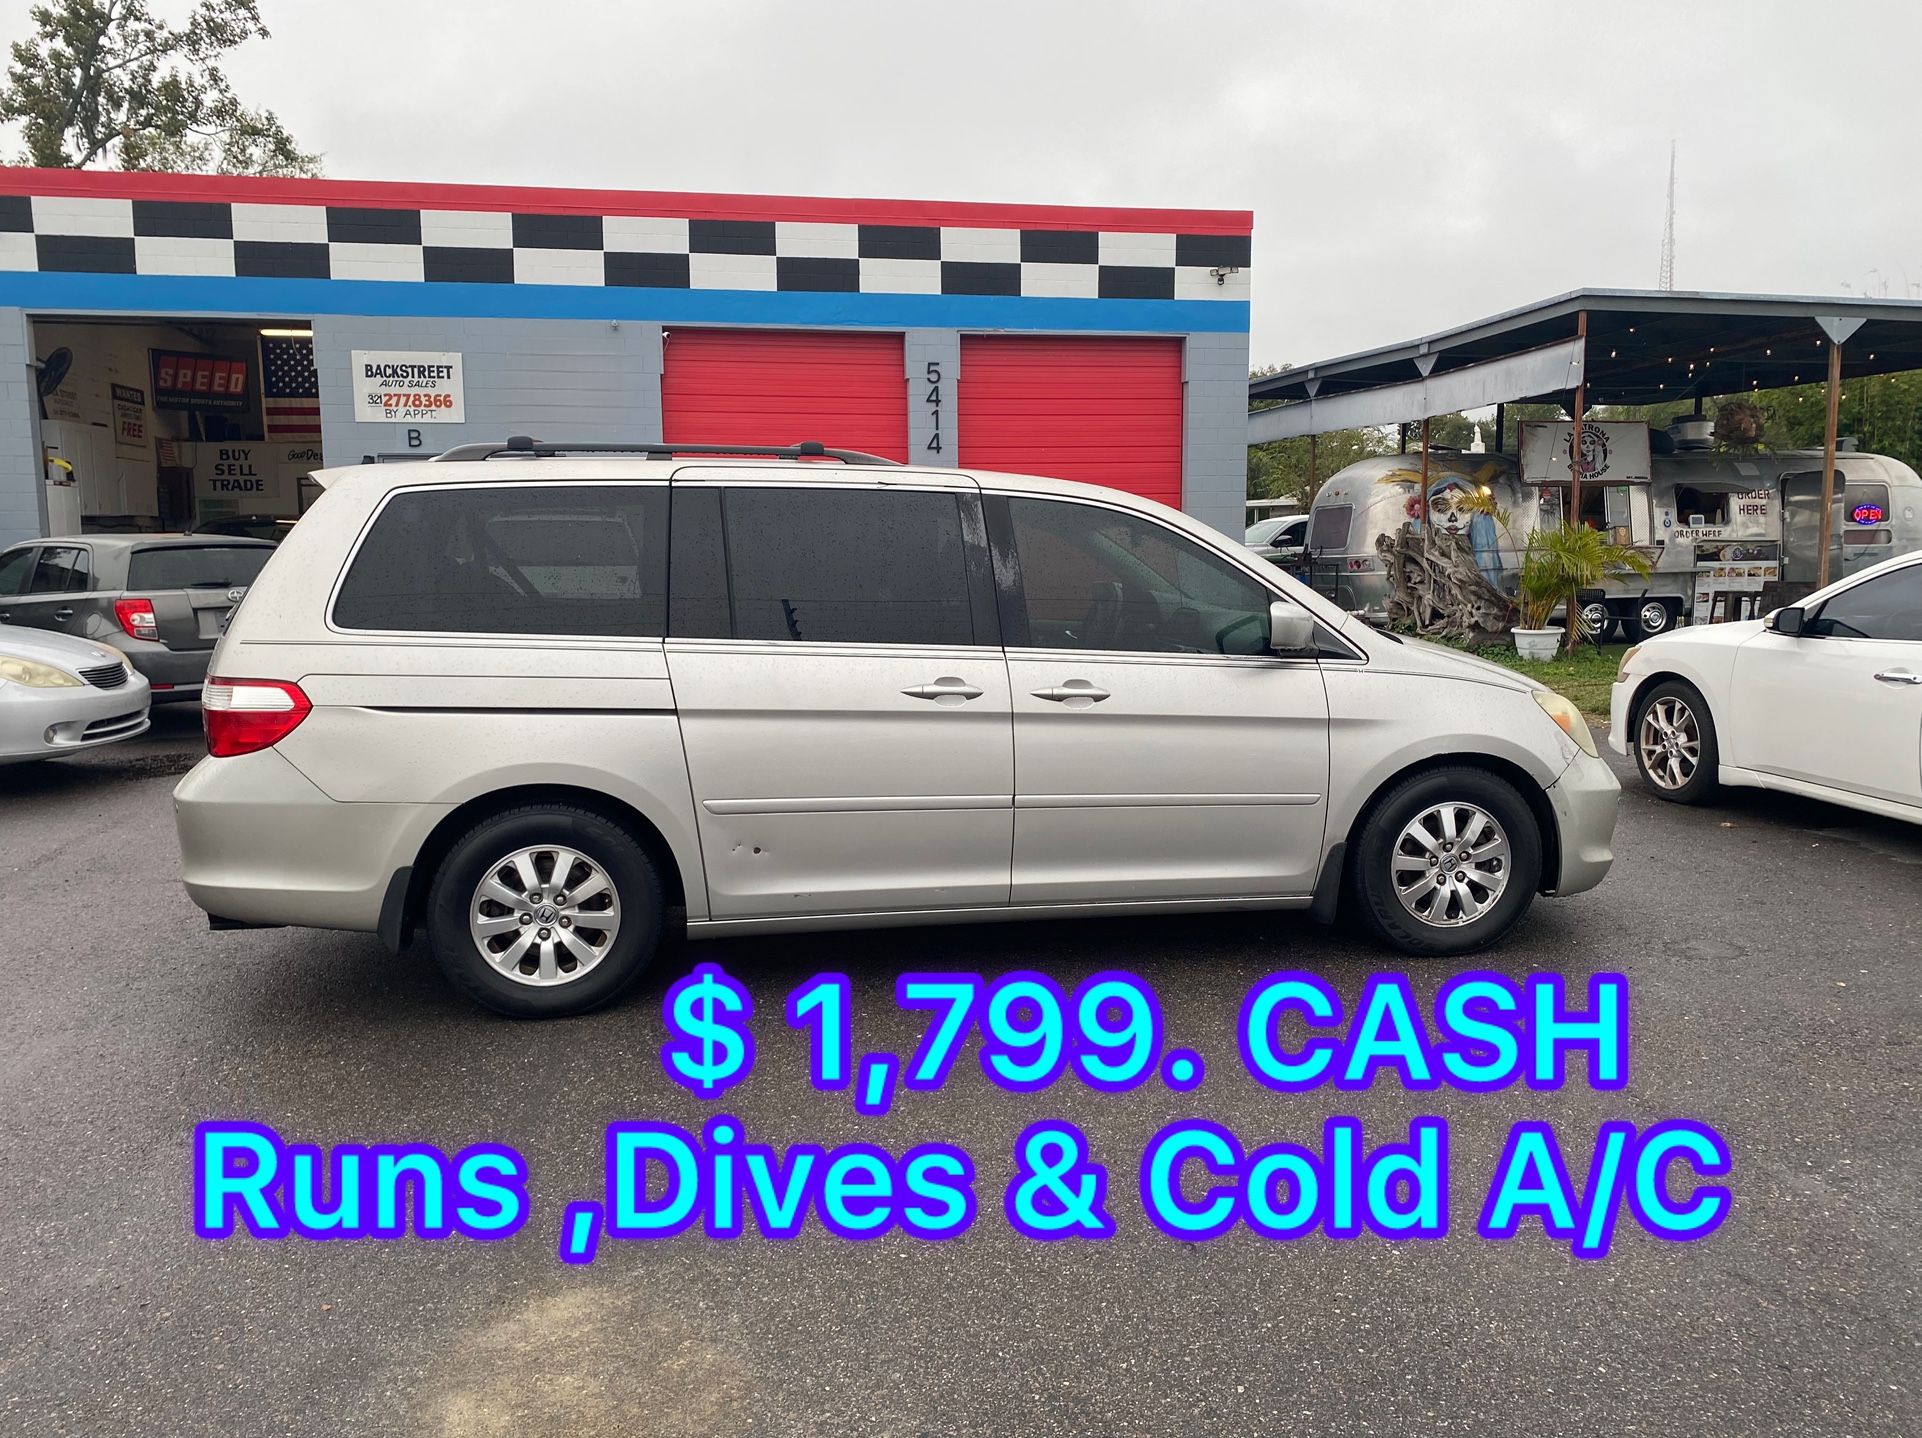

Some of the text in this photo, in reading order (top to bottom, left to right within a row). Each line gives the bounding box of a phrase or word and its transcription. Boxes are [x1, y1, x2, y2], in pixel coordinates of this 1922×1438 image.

[364, 364, 453, 379] BACKSTREET
[159, 368, 244, 392] SPEED
[379, 379, 437, 388] AUTO SALES
[367, 393, 382, 405] 321
[385, 409, 437, 419] BY APPT.
[925, 362, 942, 454] 5414
[121, 421, 143, 439] FREE
[407, 428, 422, 448] B
[1563, 432, 1574, 443] LA
[219, 449, 251, 461] BUY
[214, 463, 257, 476] SELL
[1589, 463, 1610, 479] HOUSE
[208, 479, 264, 491] TRADE
[1737, 489, 1770, 500] ORDER
[1739, 504, 1767, 515] HERE
[1854, 509, 1882, 520] OPEN
[1675, 529, 1700, 538] ORDER
